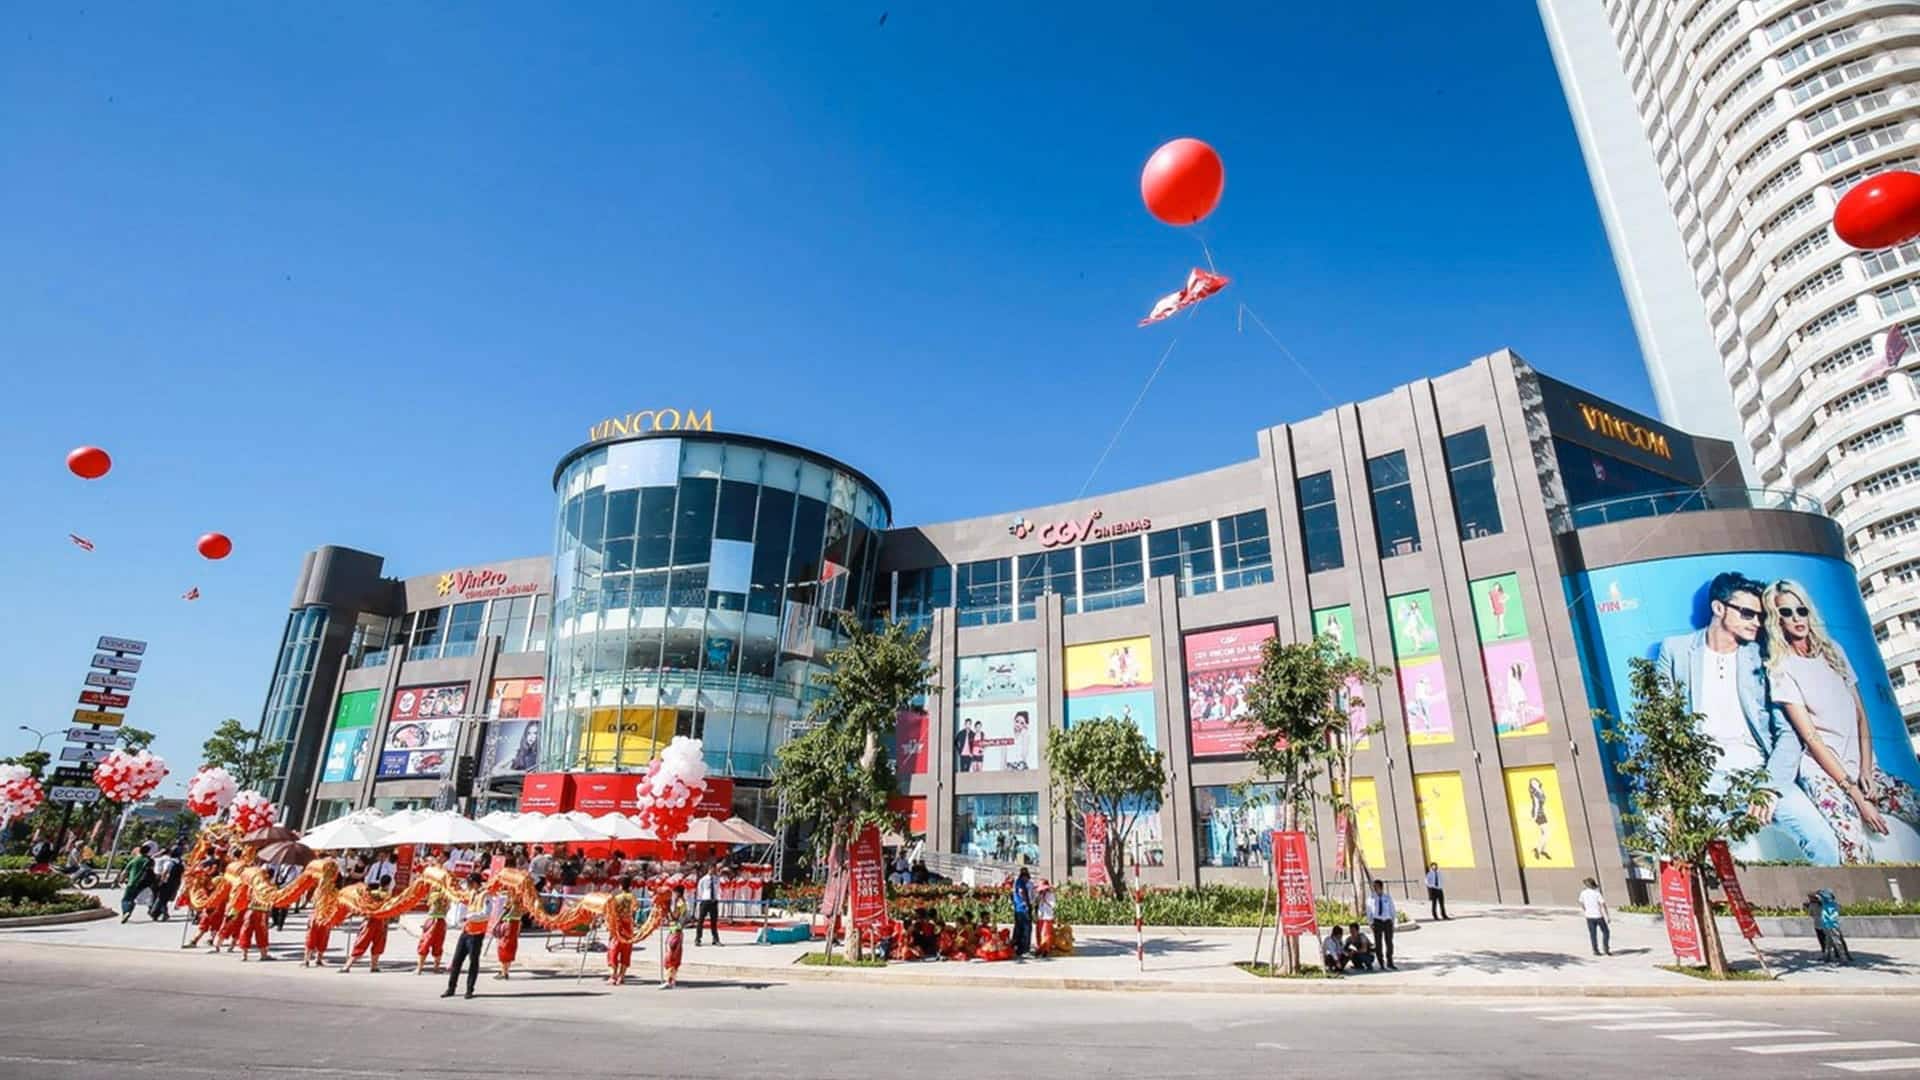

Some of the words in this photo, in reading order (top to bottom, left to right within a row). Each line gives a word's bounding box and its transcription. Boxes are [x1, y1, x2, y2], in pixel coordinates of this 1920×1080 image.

[590, 408, 713, 441] VINCOM
[1578, 402, 1672, 461] VINCOM
[1038, 516, 1096, 547] CGV
[1094, 516, 1152, 539] CINEMAS
[454, 569, 507, 595] VinPro
[54, 788, 96, 800] ecco
